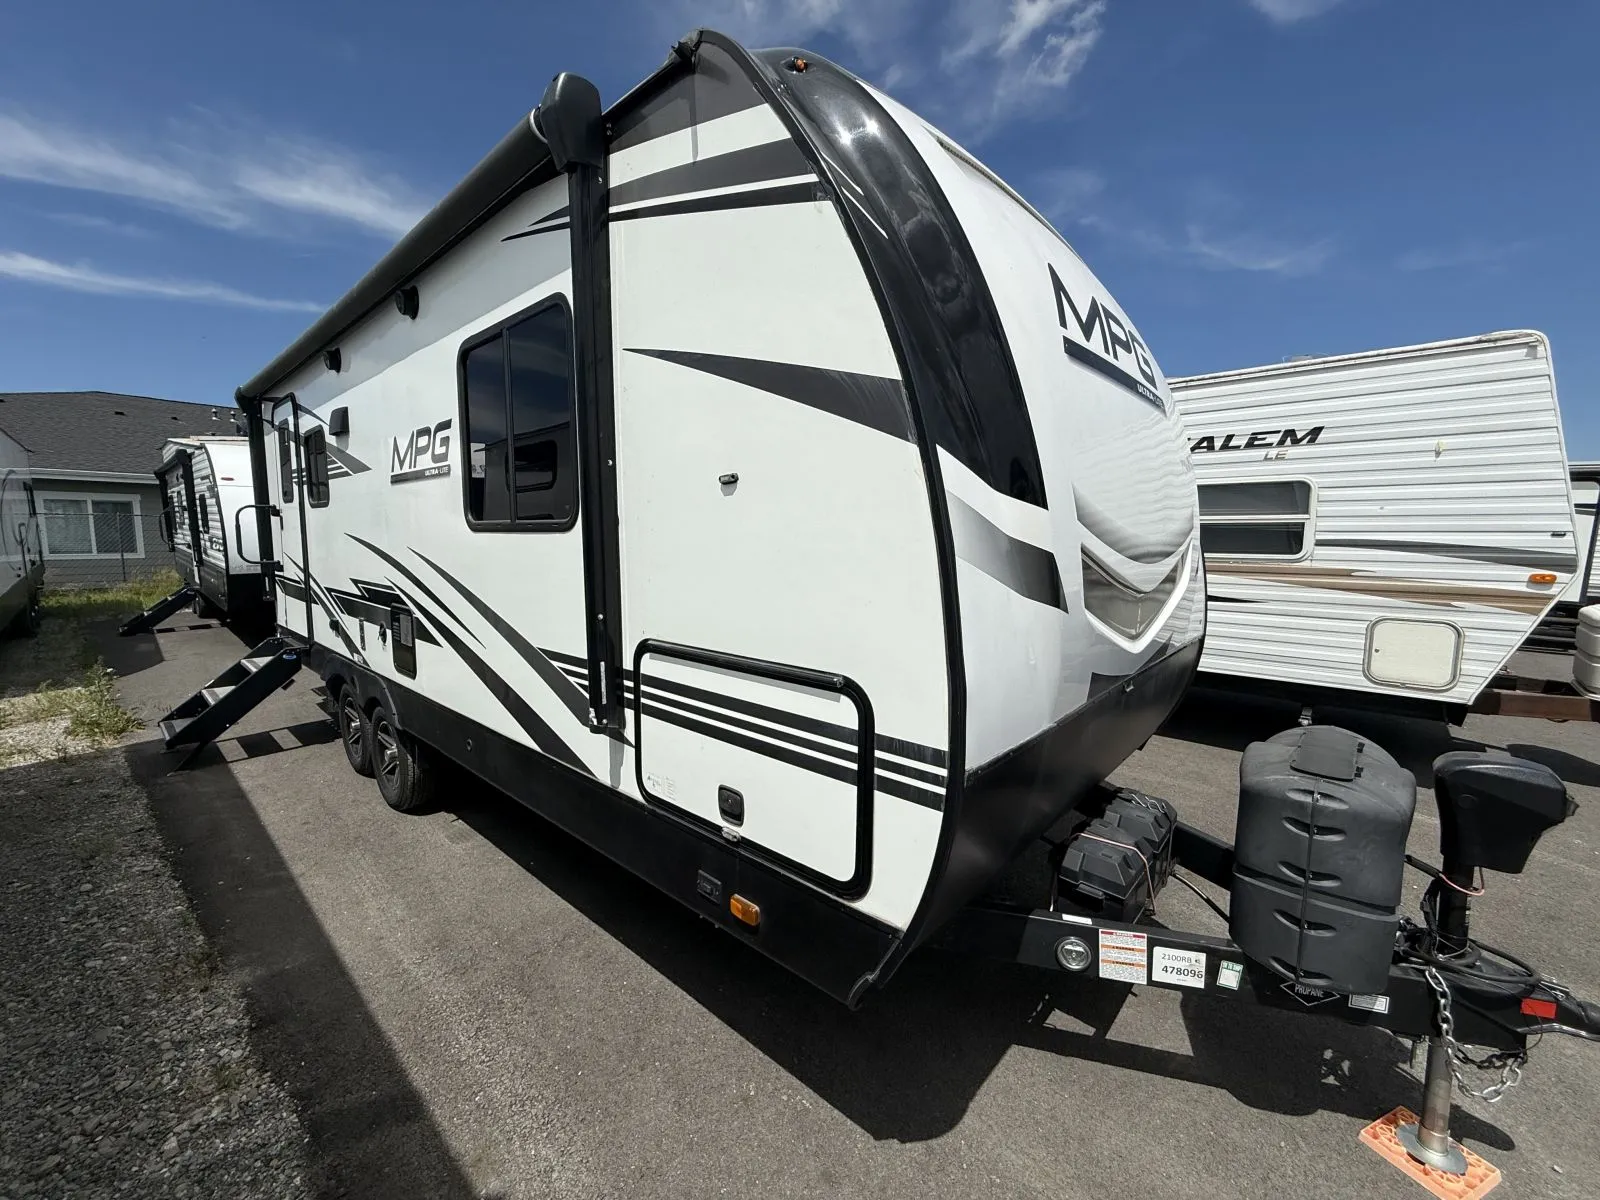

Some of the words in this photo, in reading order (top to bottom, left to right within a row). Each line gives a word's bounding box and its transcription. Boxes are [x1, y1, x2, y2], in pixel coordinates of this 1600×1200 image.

[1047, 262, 1158, 391] MPG
[391, 418, 453, 473] MPG
[1187, 425, 1325, 453] ALEM
[1263, 450, 1289, 461] LE
[1161, 953, 1192, 964] 2100RB
[1161, 965, 1204, 979] 478096
